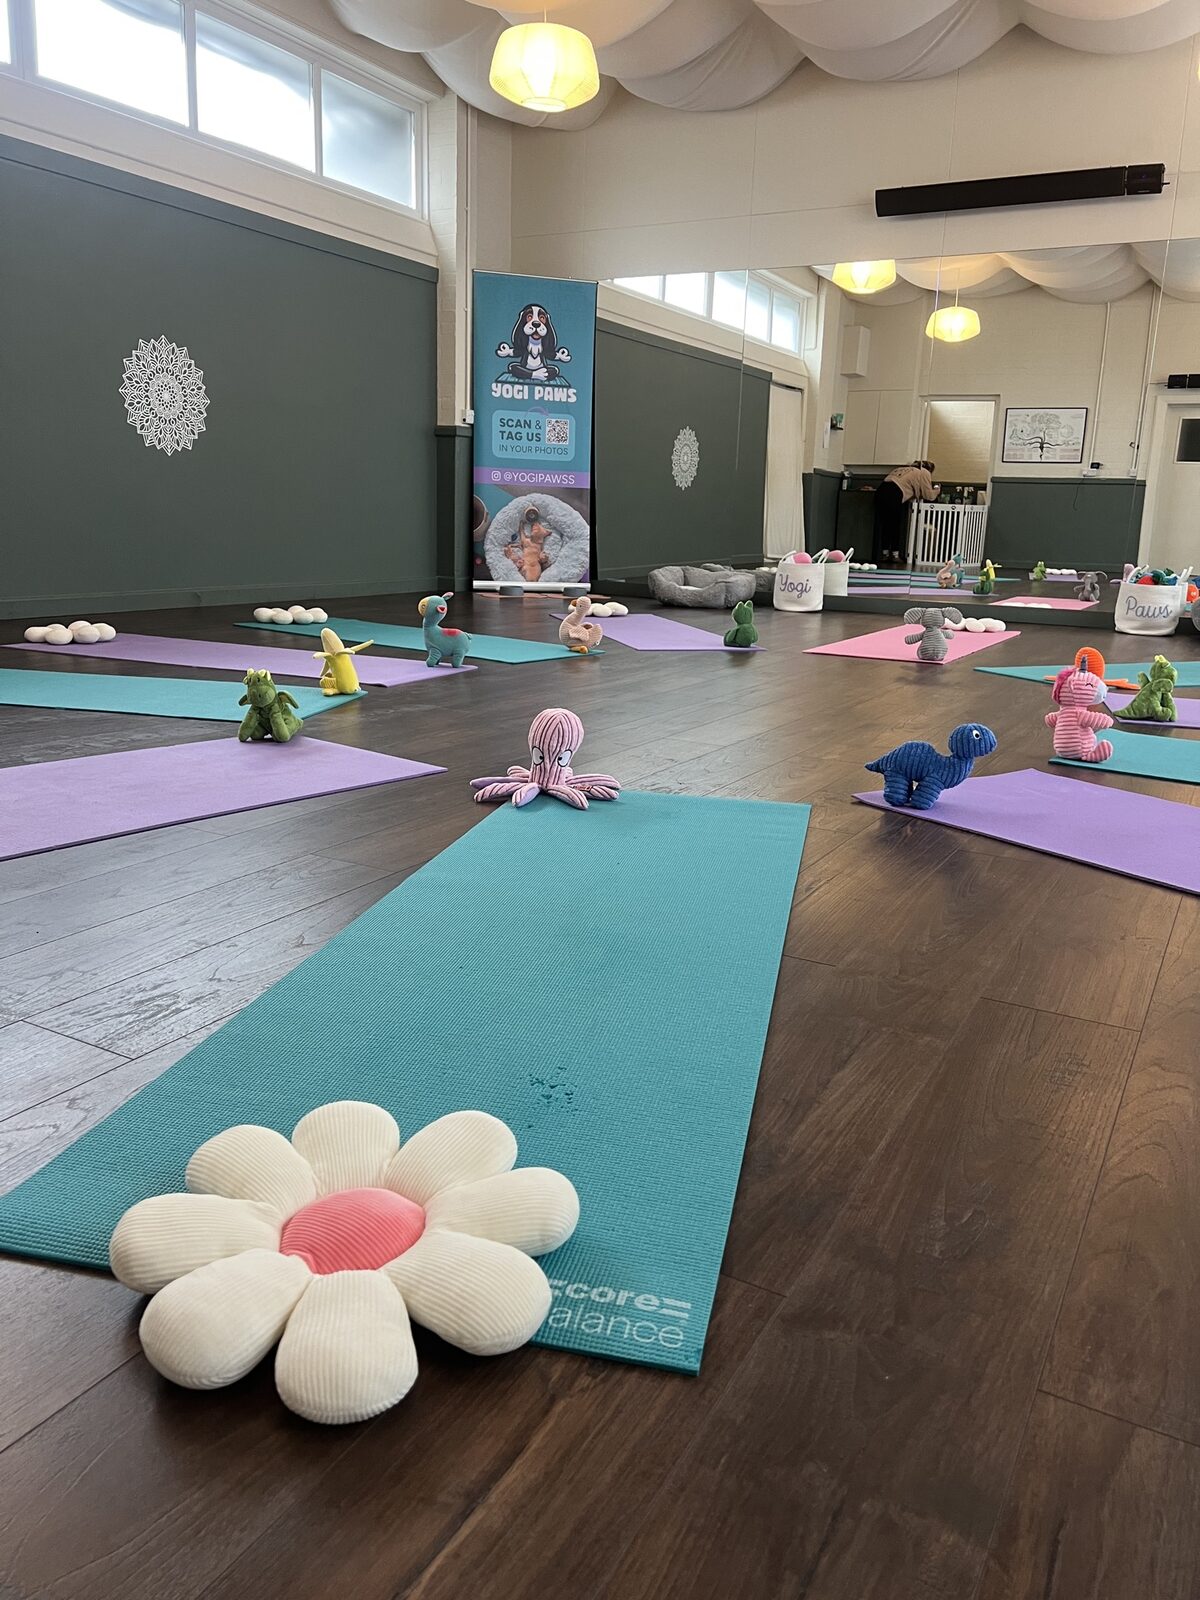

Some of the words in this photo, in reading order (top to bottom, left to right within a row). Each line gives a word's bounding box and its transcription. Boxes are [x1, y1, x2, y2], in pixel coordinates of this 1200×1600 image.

[491, 382, 529, 400] YOGI
[534, 386, 577, 403] PAWS
[499, 418, 532, 429] SCAN
[534, 420, 542, 430] &
[499, 430, 523, 441] TAG
[526, 432, 542, 442] US
[499, 444, 508, 452] IN
[510, 444, 533, 454] YOUR
[534, 446, 569, 456] PHOTOS
[503, 471, 575, 485] @YOGIPAWSS
[779, 573, 812, 599] Yogi
[1125, 595, 1173, 619] Paws
[547, 1304, 684, 1349] alance
